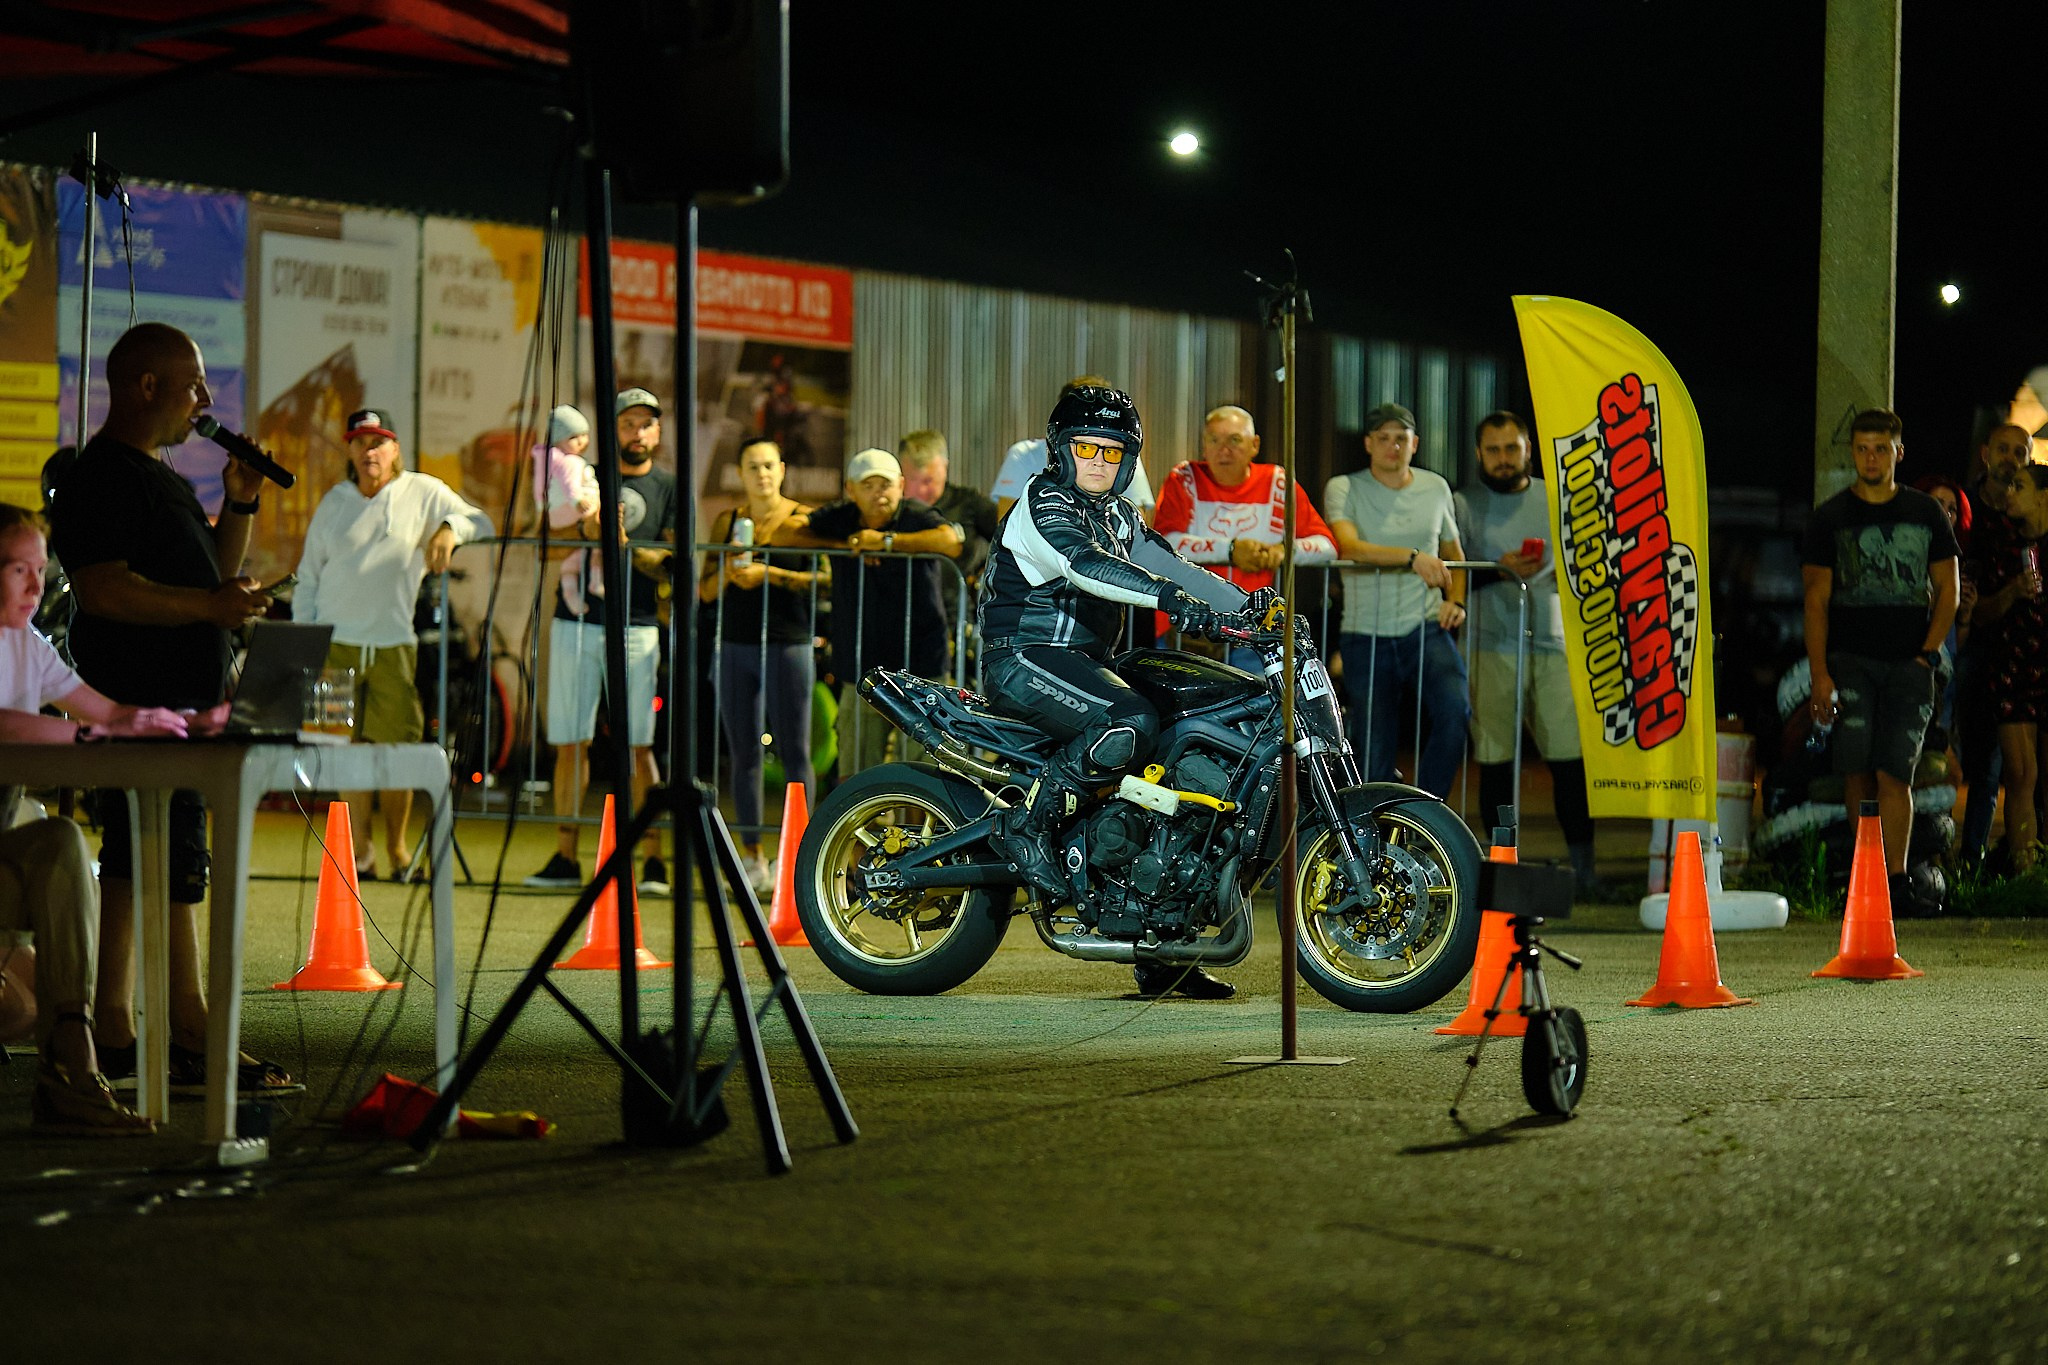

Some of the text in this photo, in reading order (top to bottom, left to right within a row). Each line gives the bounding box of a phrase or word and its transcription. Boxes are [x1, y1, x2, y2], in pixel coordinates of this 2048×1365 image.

[1095, 406, 1121, 418] Arai
[1178, 538, 1216, 554] FOX
[1302, 669, 1324, 693] 100
[1026, 676, 1090, 714] SPIDI
